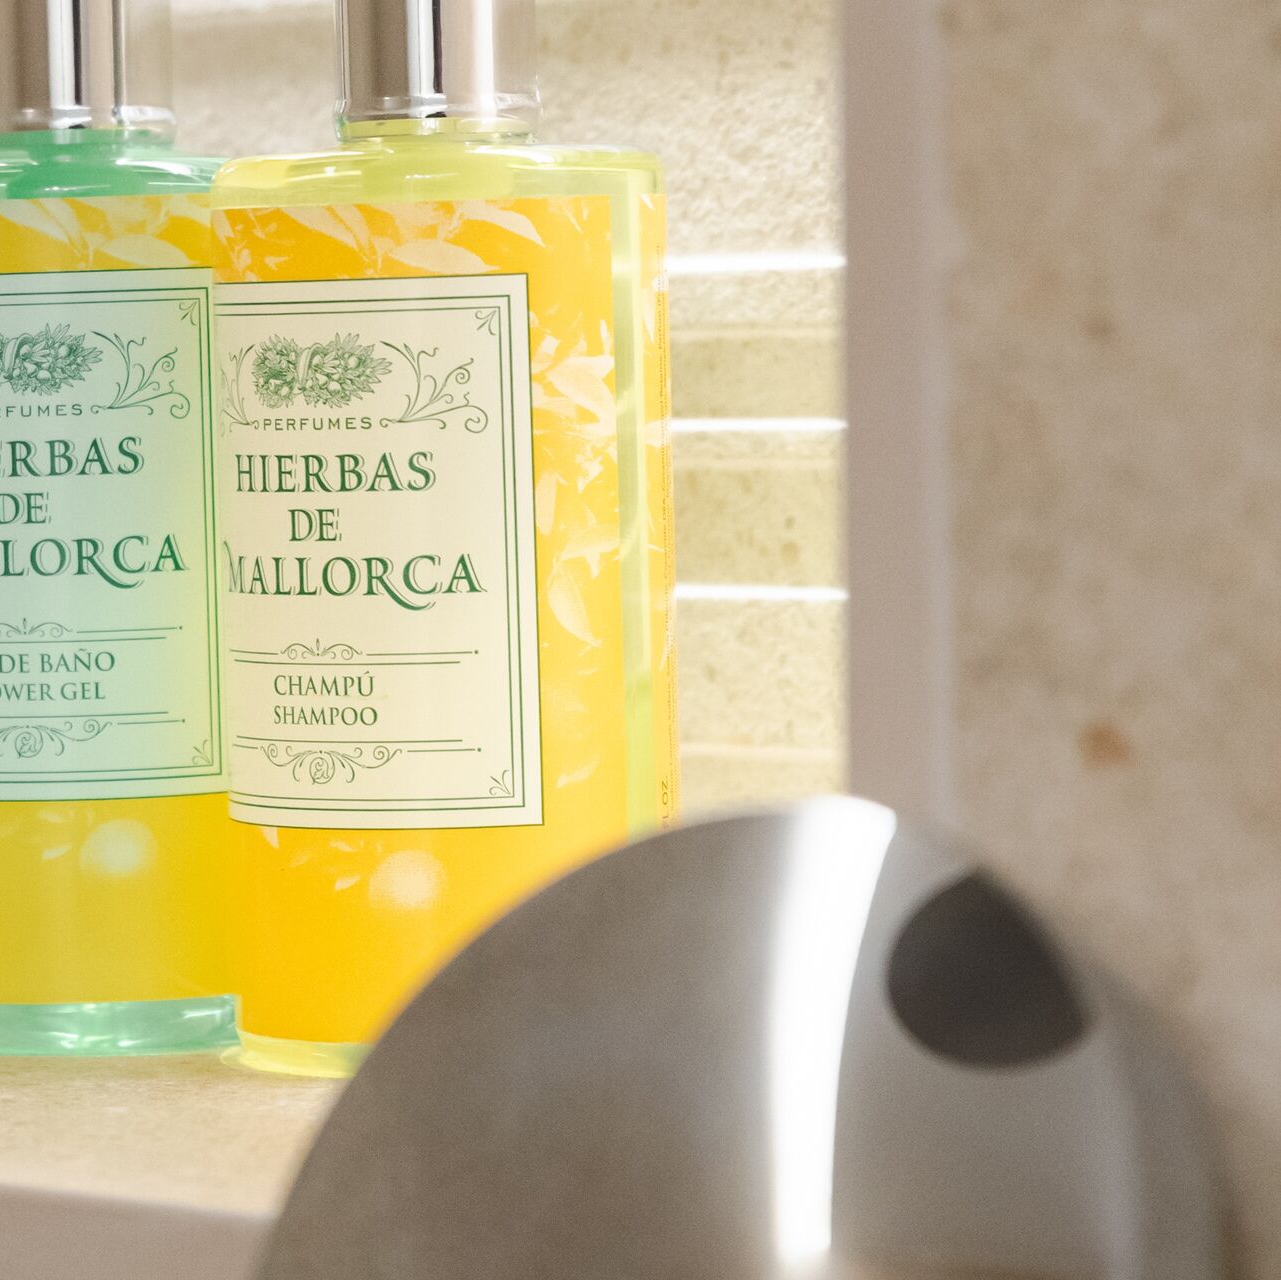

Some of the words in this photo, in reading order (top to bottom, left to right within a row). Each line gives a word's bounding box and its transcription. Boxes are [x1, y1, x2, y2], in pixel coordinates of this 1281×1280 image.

[263, 416, 373, 431] PERFUMES
[235, 451, 437, 493] HIERBAS
[287, 508, 342, 542] DE
[223, 540, 488, 611] MALLORCA
[40, 648, 115, 673] BAÑO
[60, 681, 106, 700] GEL
[274, 670, 375, 697] CHAMPÚ
[274, 705, 378, 726] SHAMPOO
